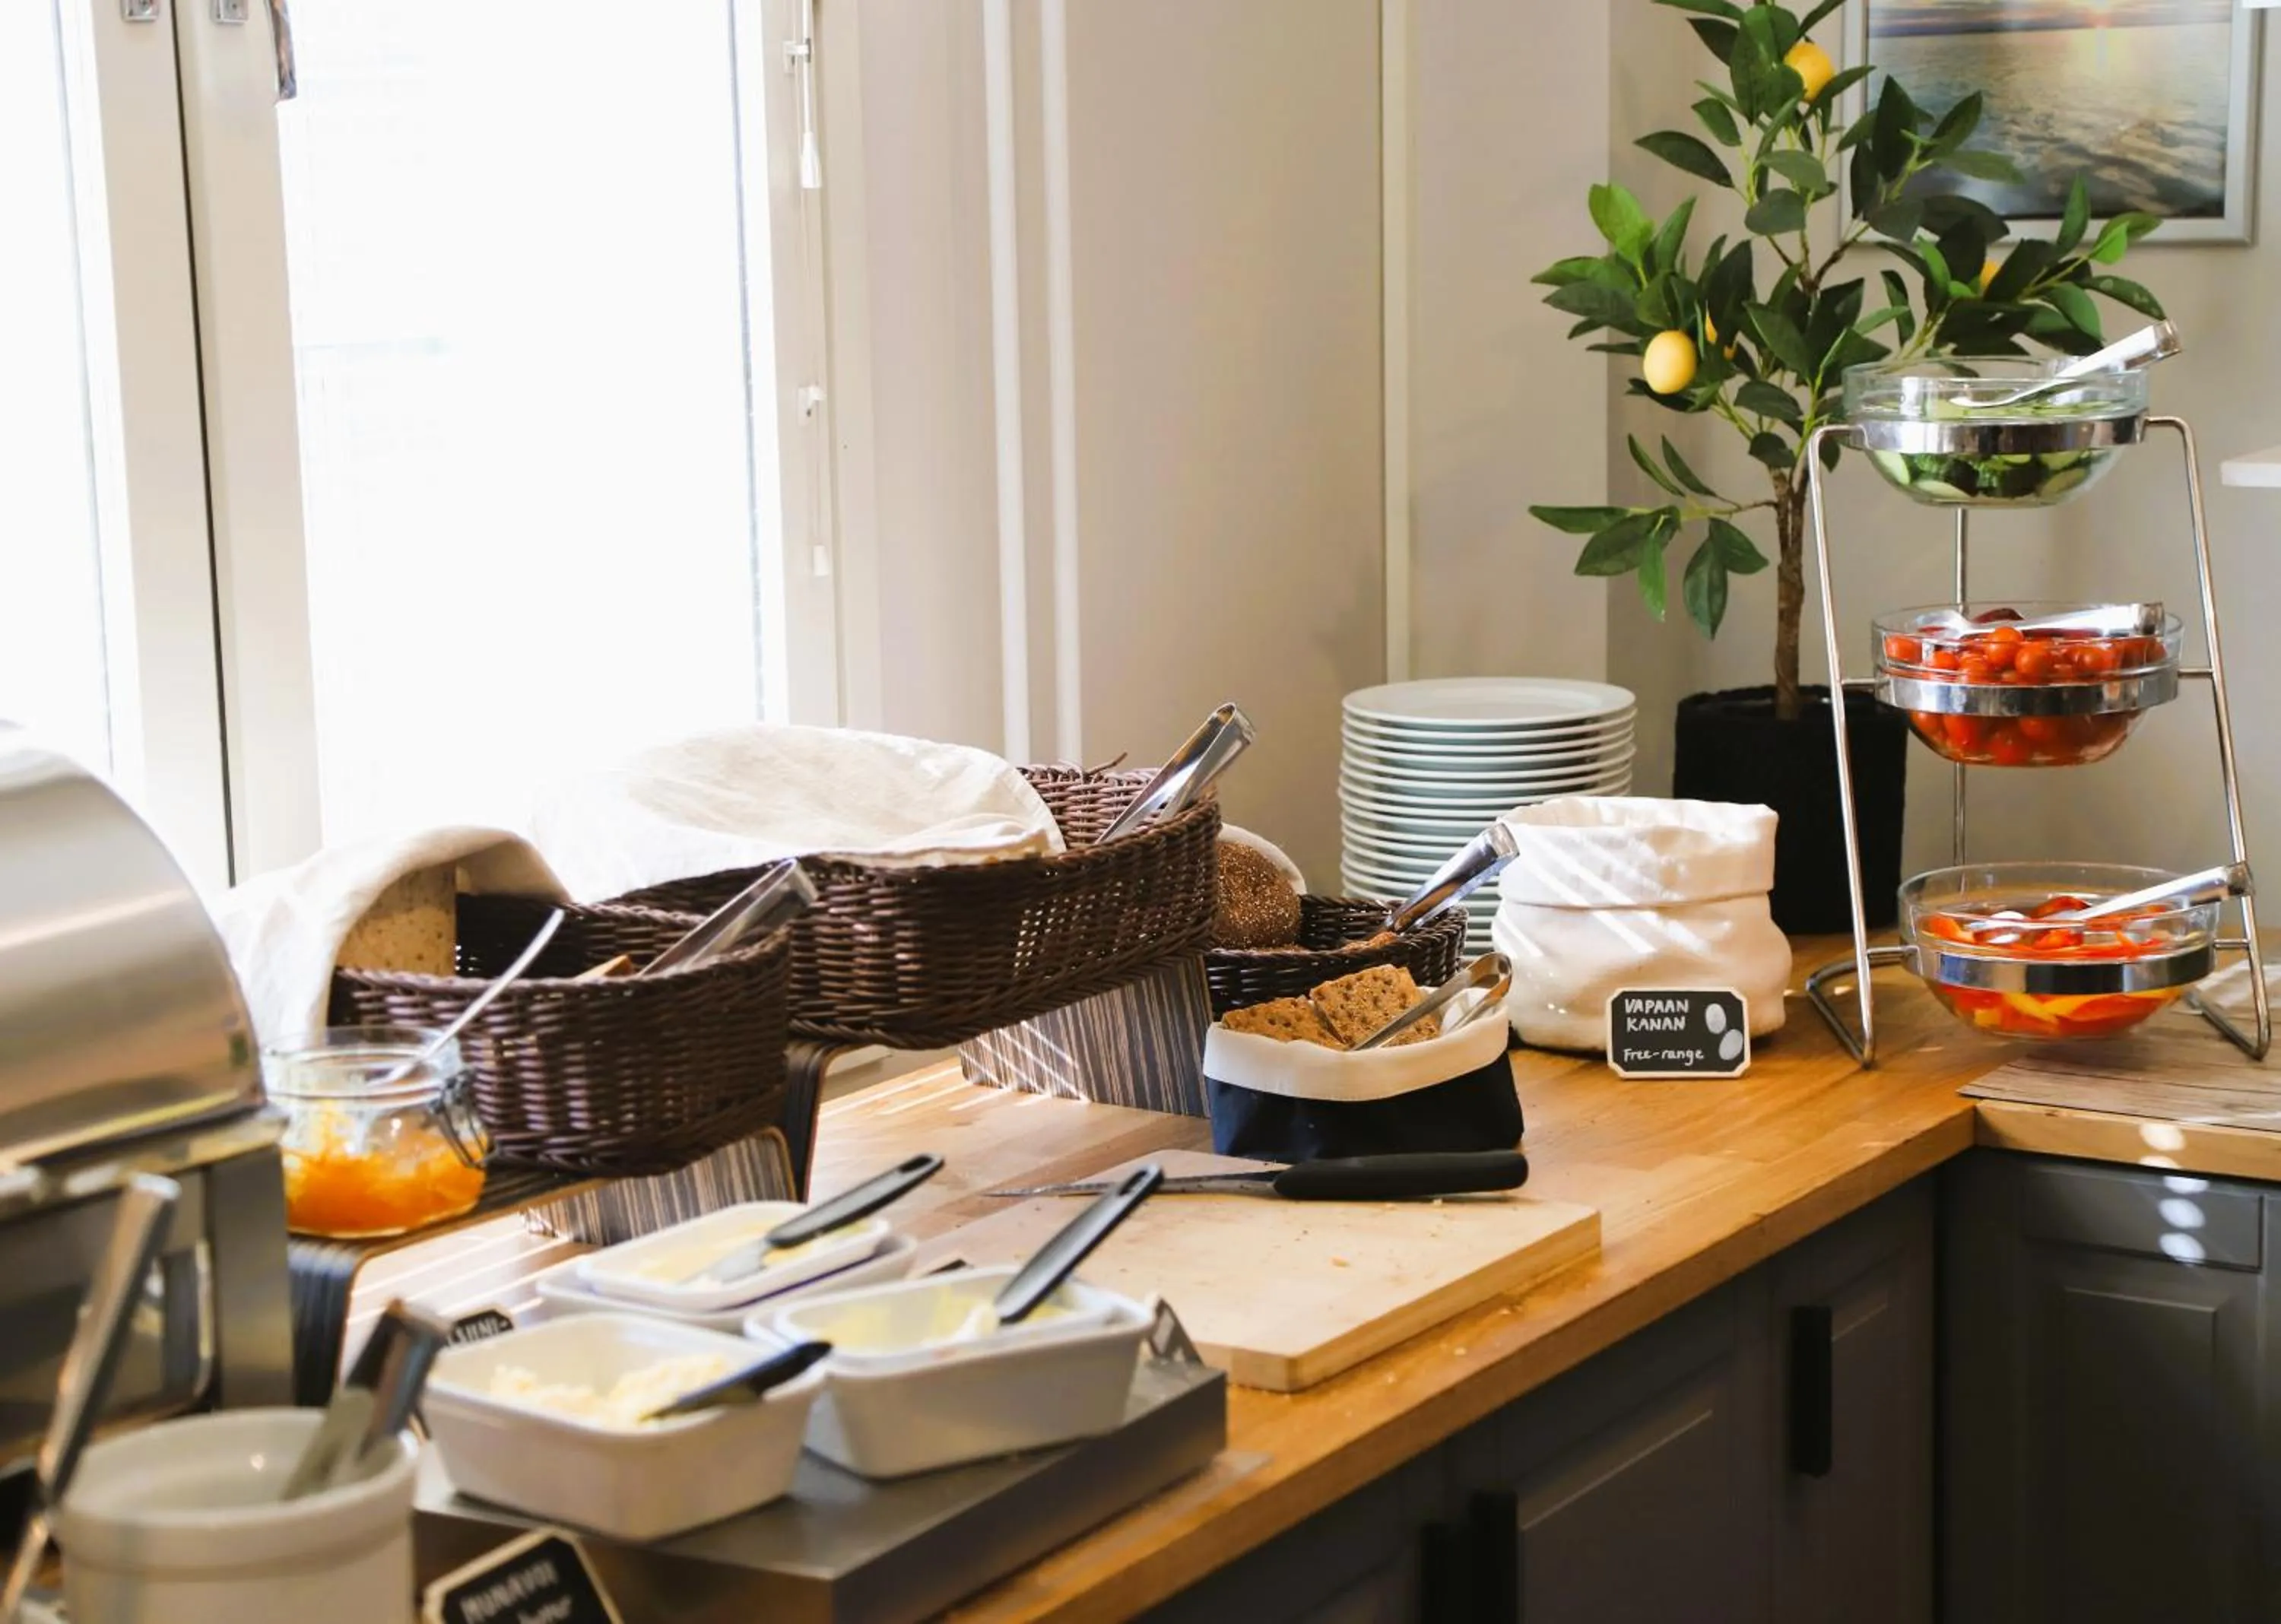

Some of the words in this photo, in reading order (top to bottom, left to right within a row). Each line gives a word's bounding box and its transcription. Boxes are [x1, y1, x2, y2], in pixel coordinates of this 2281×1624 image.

[1624, 998, 1689, 1014] VAPAAN
[1626, 1015, 1686, 1032] KANAN
[1623, 1048, 1705, 1067] Free-range
